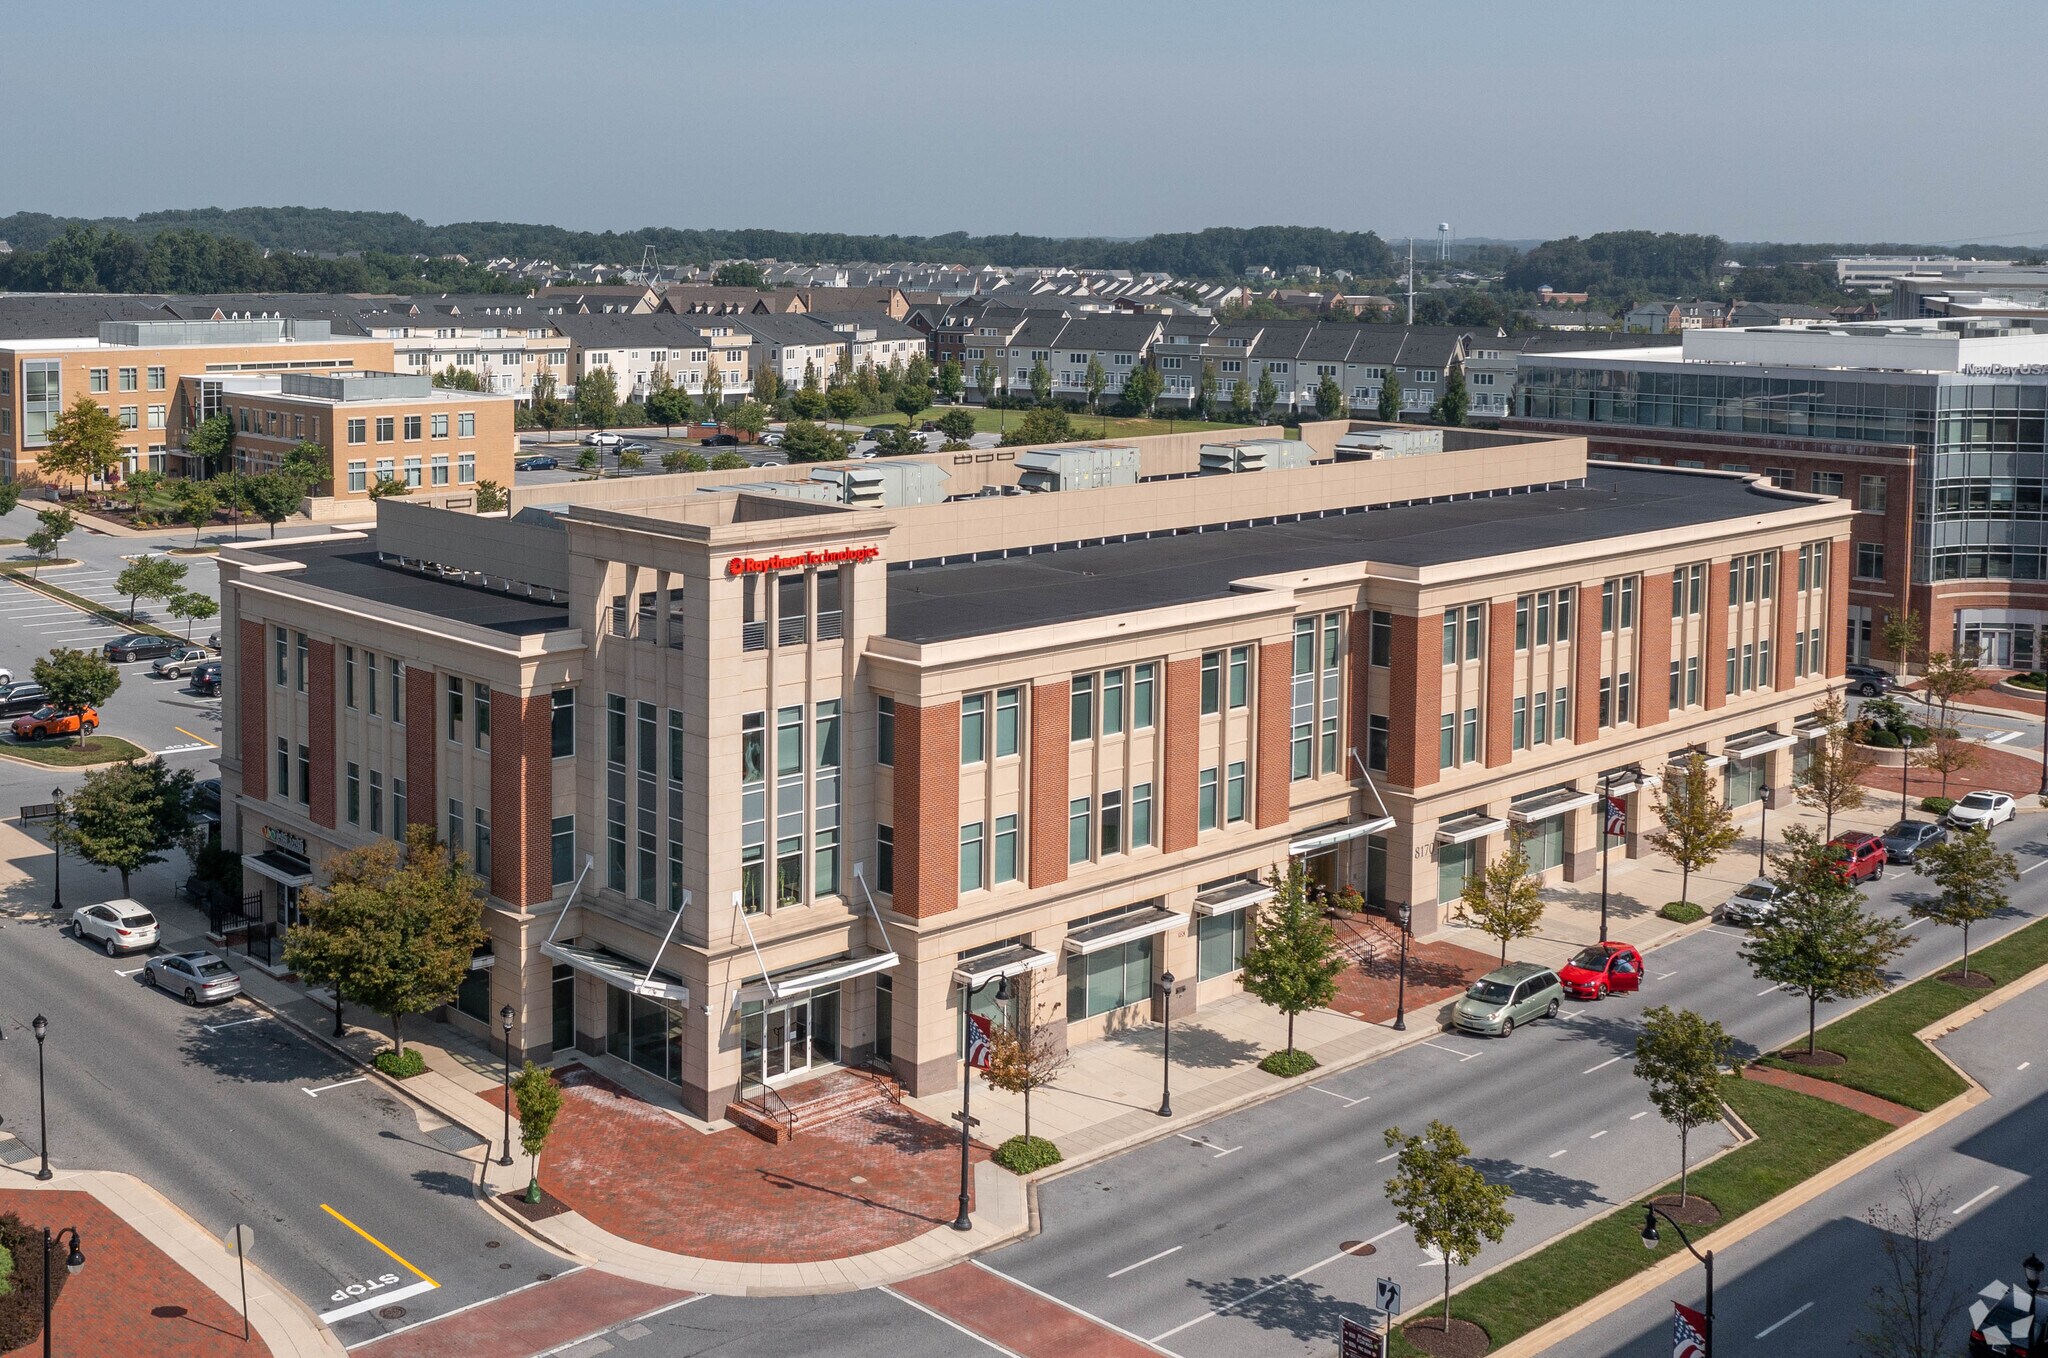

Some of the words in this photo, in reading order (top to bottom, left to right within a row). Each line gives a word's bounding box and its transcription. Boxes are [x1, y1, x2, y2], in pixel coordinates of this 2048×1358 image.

[1965, 363, 2017, 376] NewDay
[745, 555, 805, 573] Raytheon
[804, 546, 879, 565] Technologies
[1414, 842, 1435, 860] 8170
[330, 1273, 400, 1302] STOP
